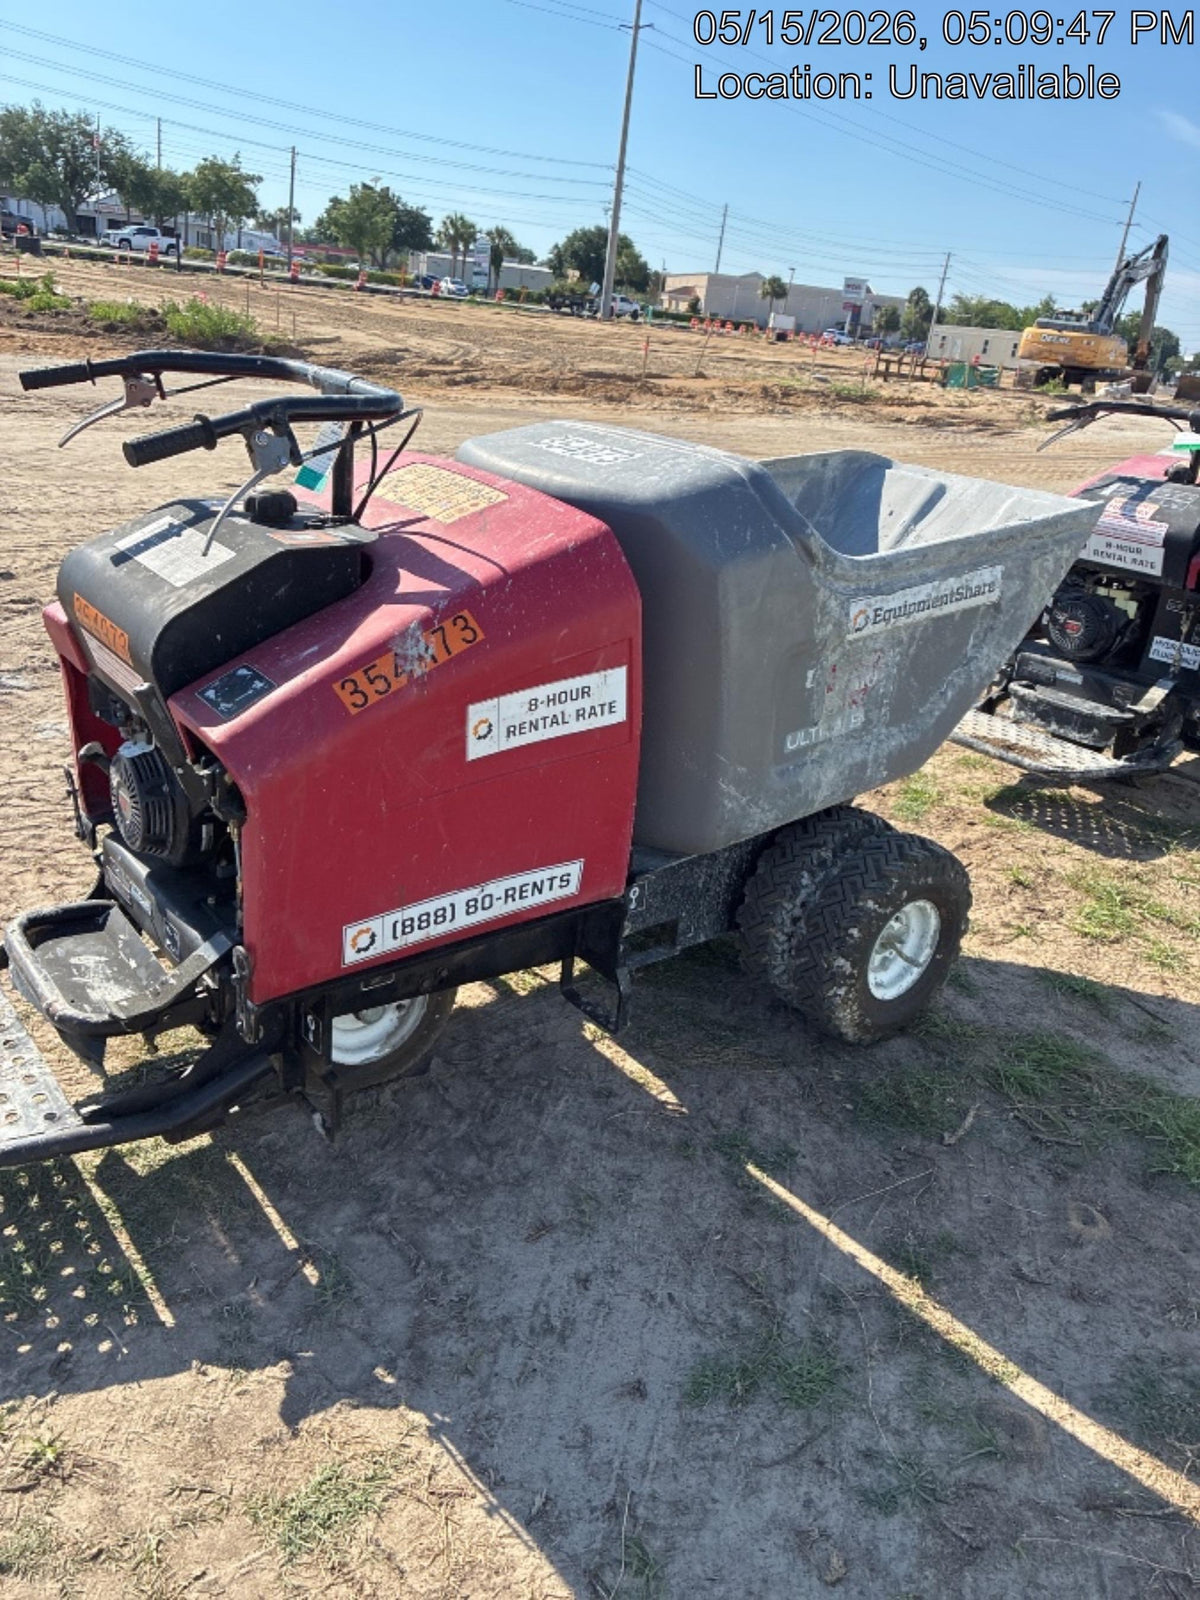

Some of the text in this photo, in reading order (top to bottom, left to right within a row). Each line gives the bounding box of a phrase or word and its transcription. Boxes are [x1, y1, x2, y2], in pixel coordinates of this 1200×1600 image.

[1093, 549, 1156, 570] RENTAL RATE
[870, 579, 997, 628] EquipmentShare
[340, 614, 478, 709] 35473
[505, 701, 618, 739] RENTAL RATE
[527, 684, 592, 713] 8-HOUR
[391, 872, 572, 941] (888) 80-RENTS
